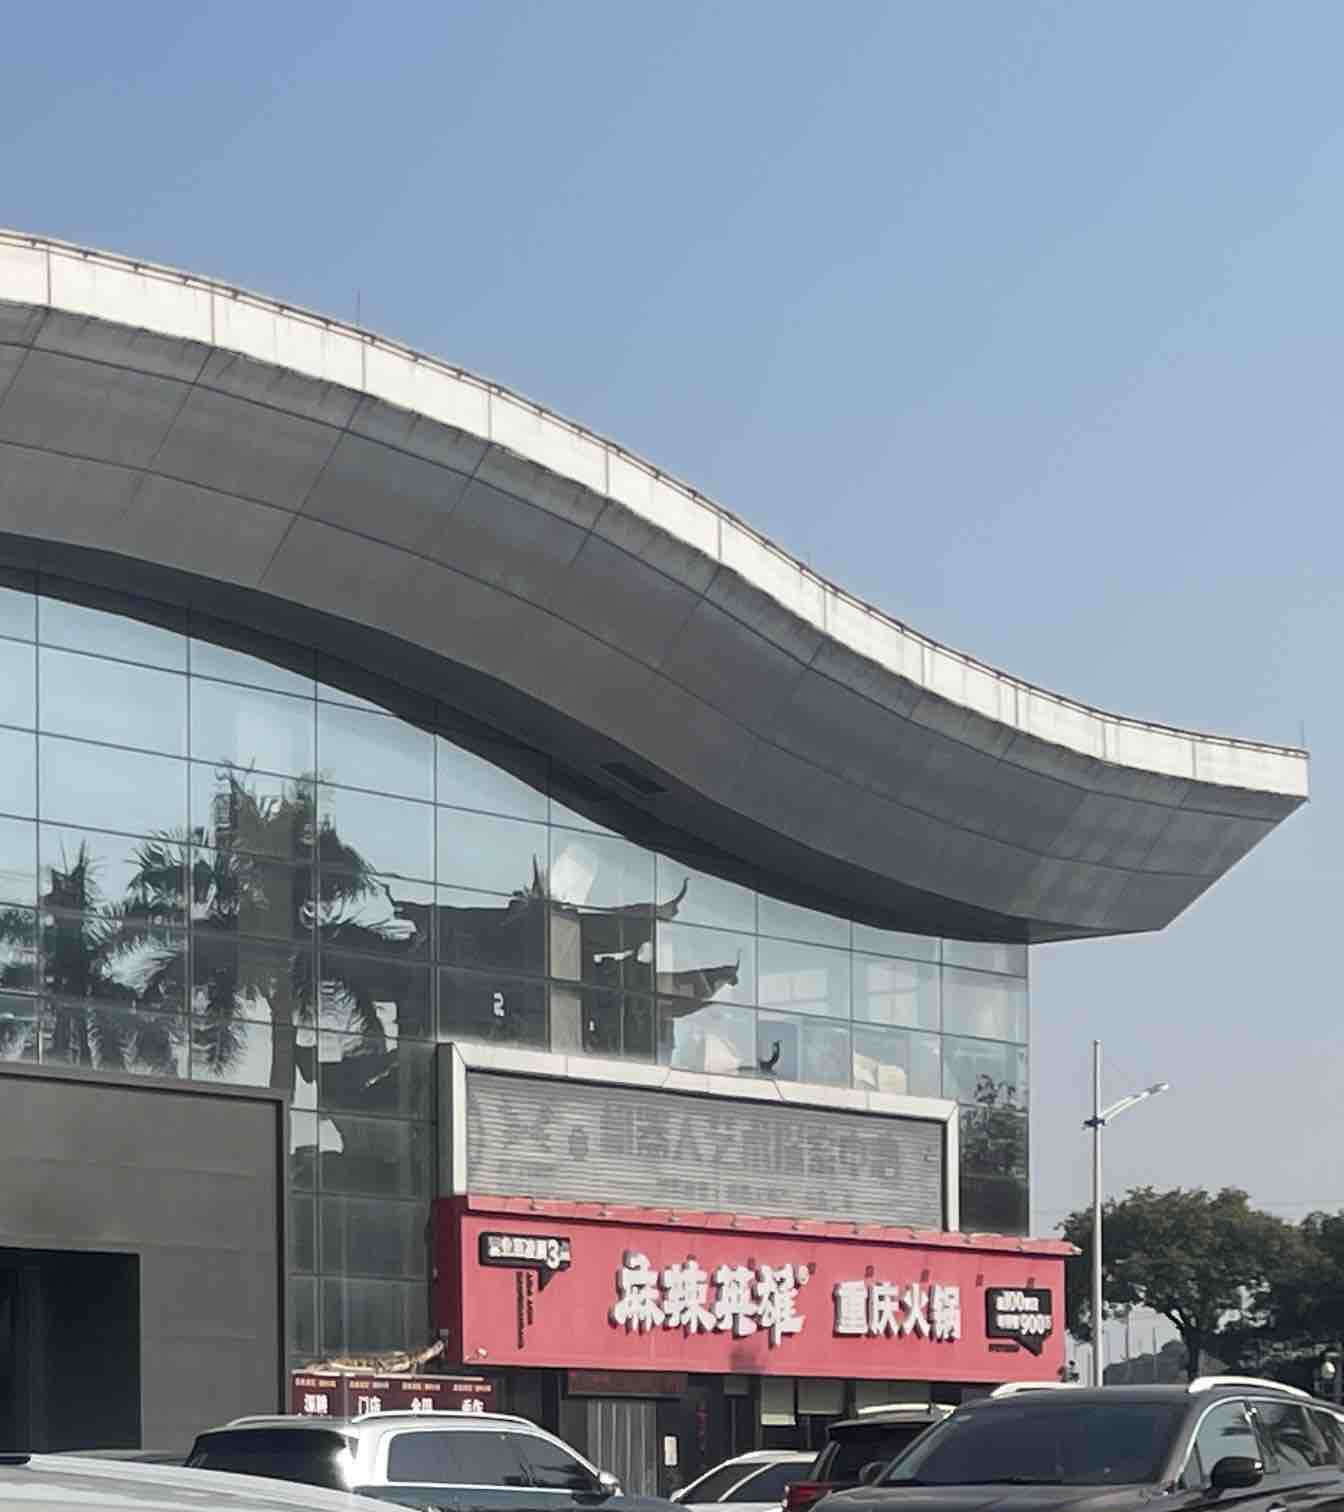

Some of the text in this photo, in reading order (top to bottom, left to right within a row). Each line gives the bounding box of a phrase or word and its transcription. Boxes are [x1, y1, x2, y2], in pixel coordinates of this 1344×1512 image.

[611, 1251, 806, 1346] 麻辣英雄
[836, 1279, 961, 1340] 重庆火锅
